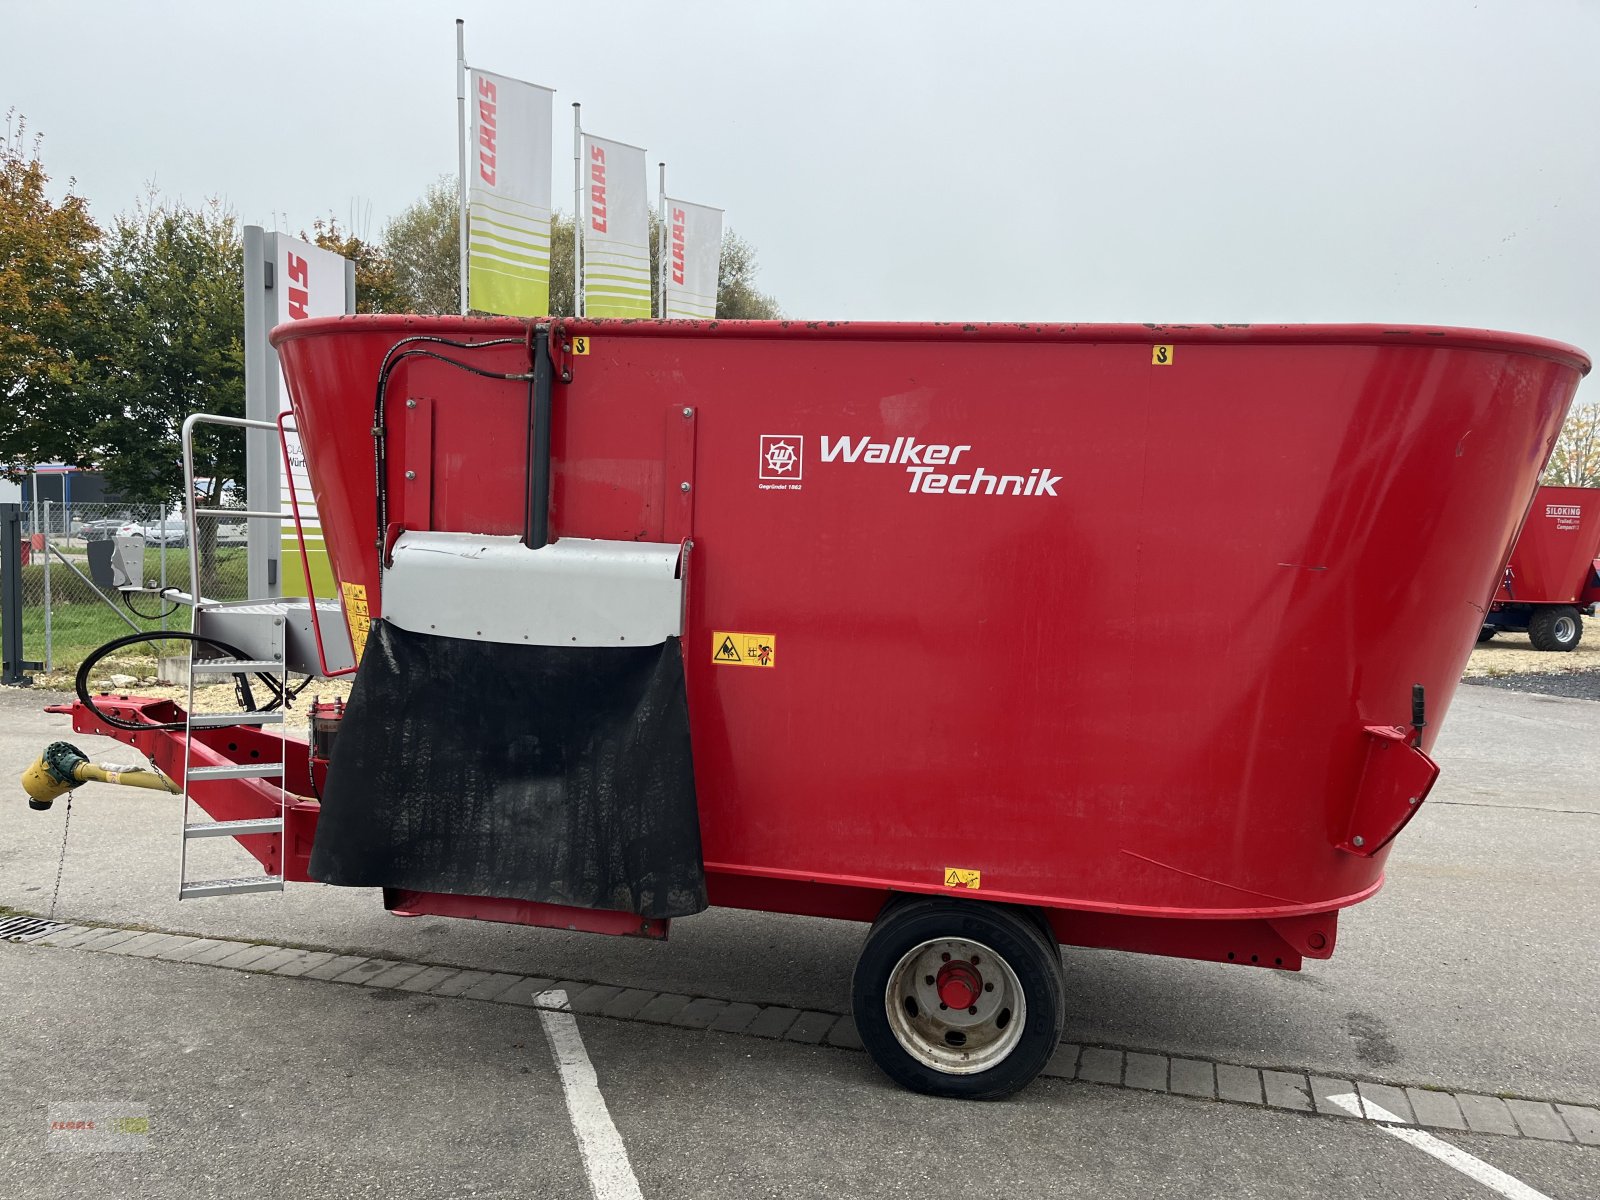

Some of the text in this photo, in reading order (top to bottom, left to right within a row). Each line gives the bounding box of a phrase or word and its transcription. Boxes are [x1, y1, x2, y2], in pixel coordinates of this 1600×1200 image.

[479, 76, 496, 187] CLAAS
[591, 144, 607, 234] CLAAS
[672, 207, 686, 285] CLAAS
[286, 444, 303, 455] CLA
[820, 435, 971, 465] Walker
[906, 466, 1063, 497] Technik
[1545, 507, 1581, 515] SILOKING
